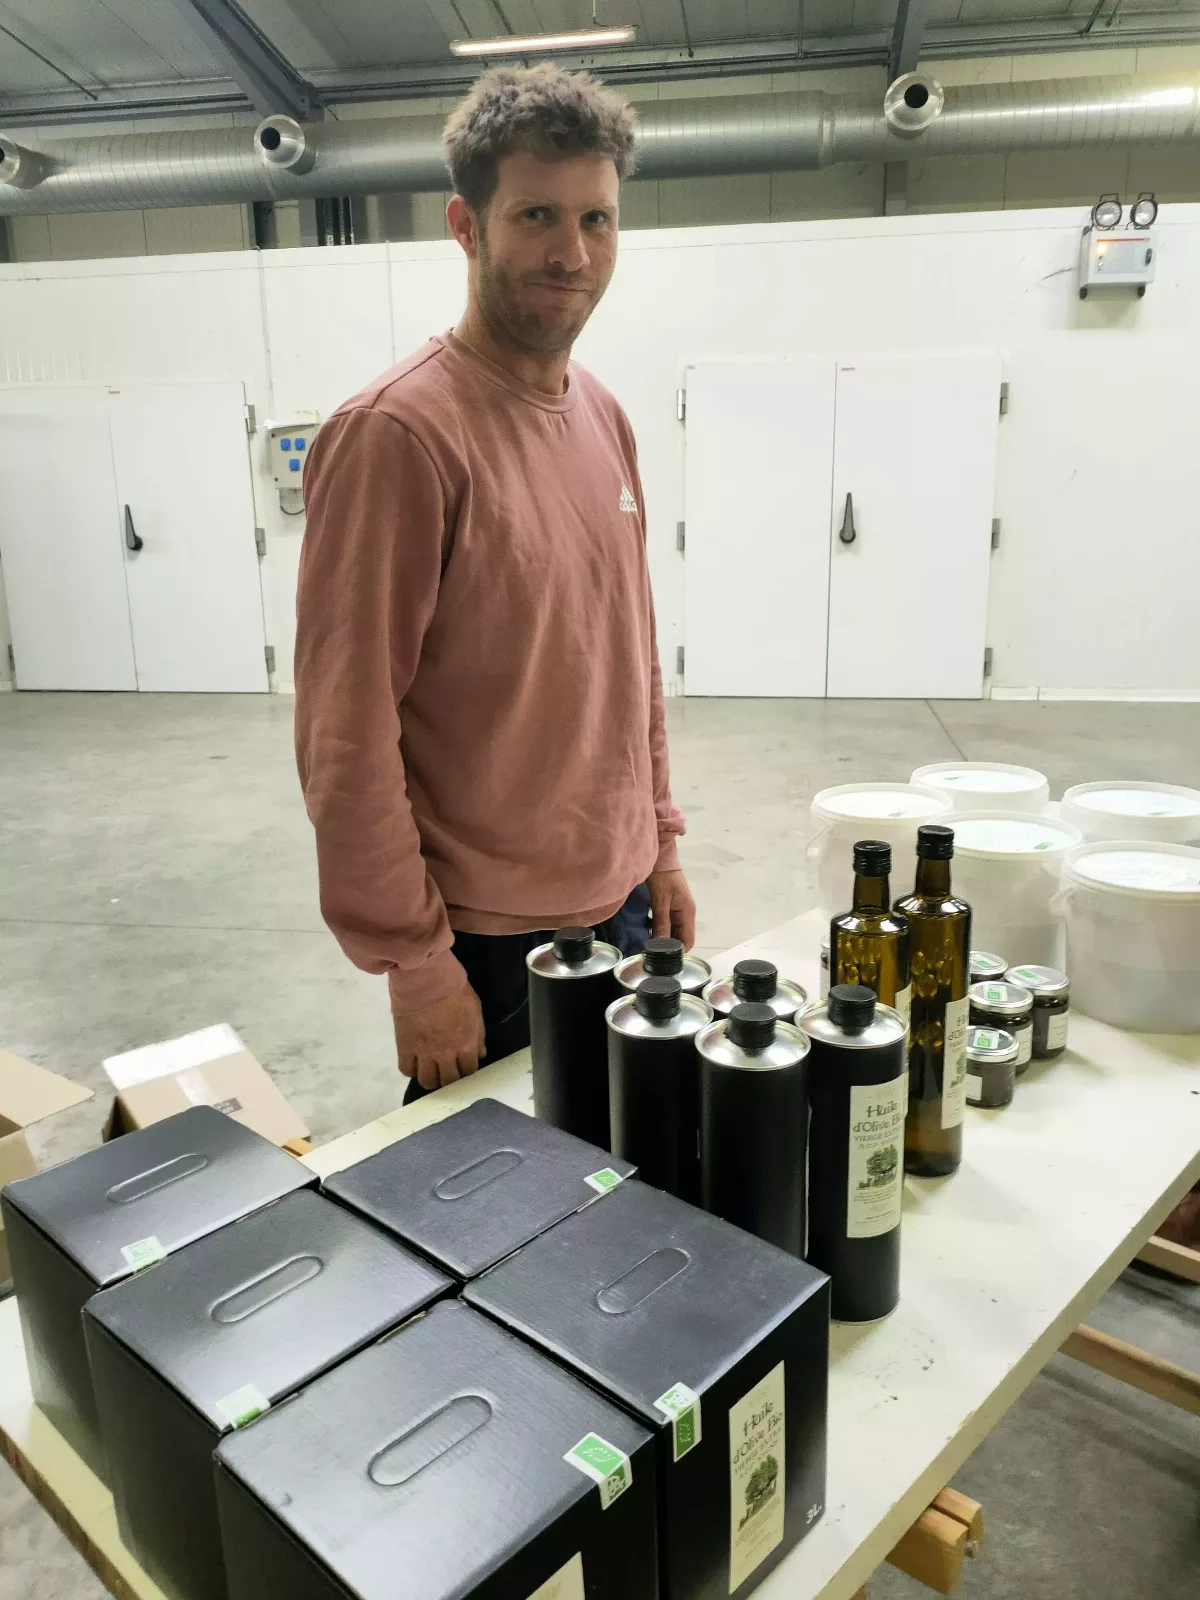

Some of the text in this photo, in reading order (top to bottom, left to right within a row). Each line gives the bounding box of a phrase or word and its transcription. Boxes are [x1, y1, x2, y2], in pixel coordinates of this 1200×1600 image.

[865, 1100, 898, 1118] Huile
[743, 1400, 774, 1437] Huile
[767, 1412, 783, 1432] Bio
